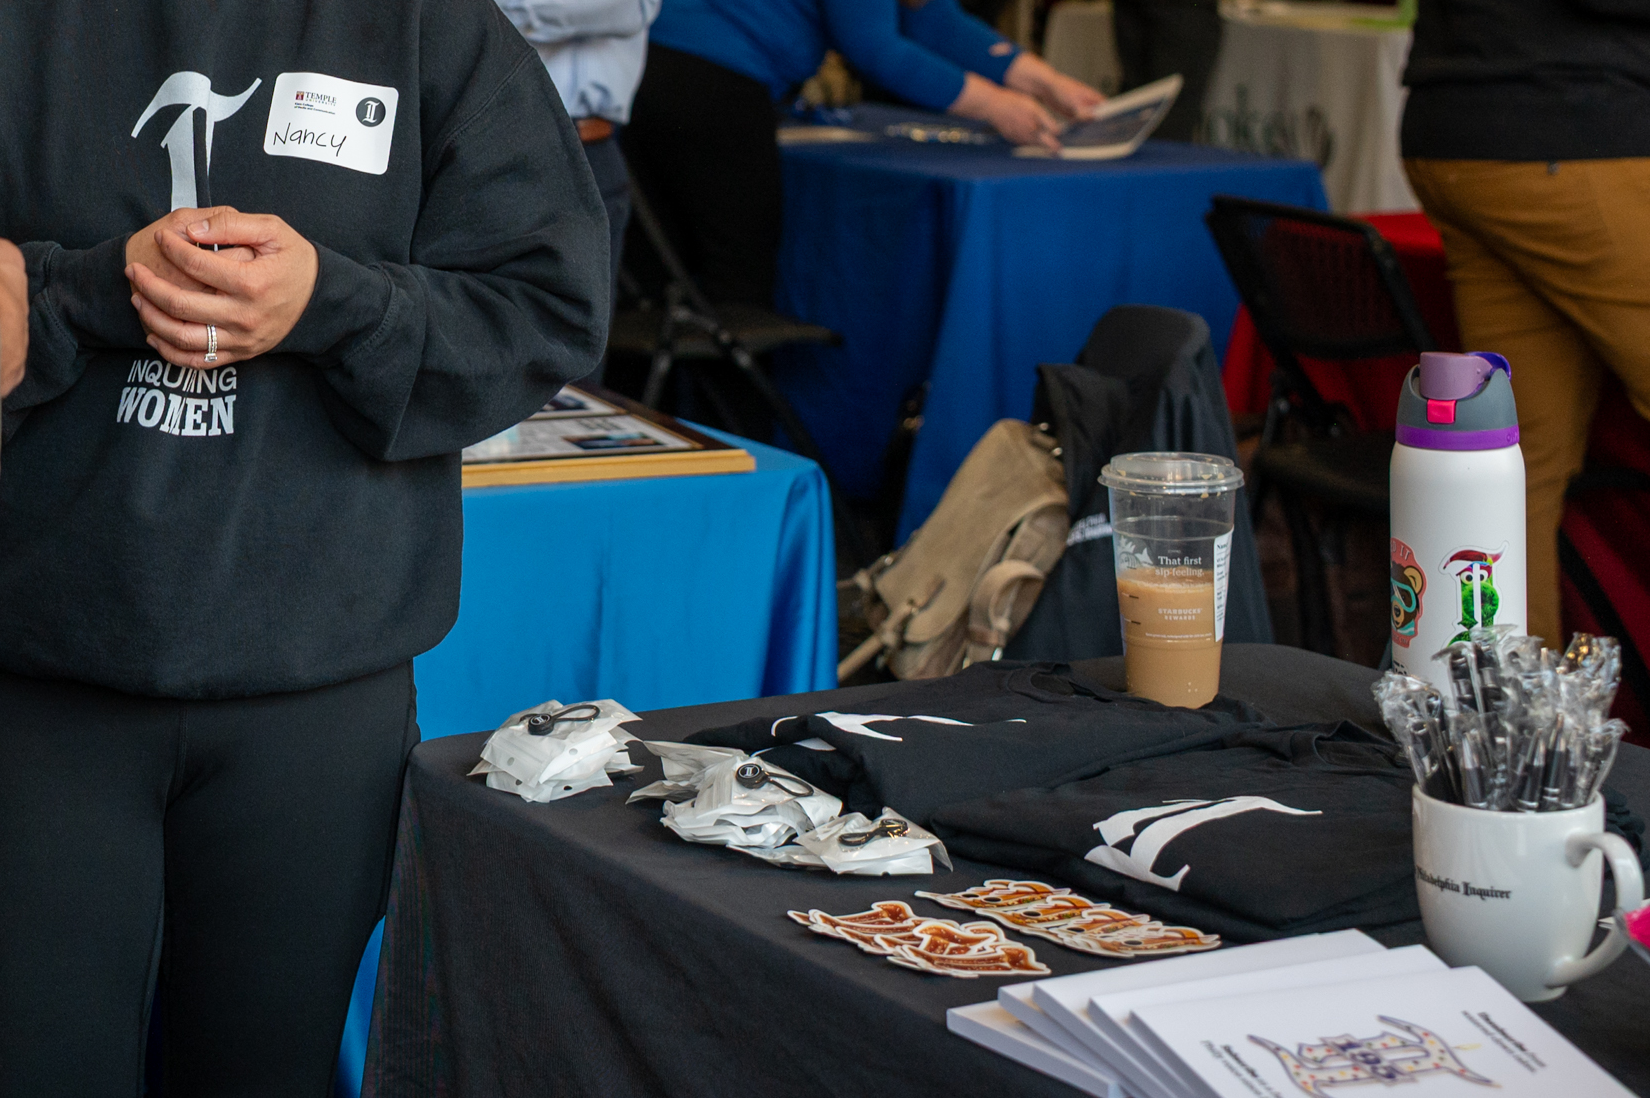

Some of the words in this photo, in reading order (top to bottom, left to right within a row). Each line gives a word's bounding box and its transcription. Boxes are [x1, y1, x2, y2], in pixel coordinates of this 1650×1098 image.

[305, 91, 337, 104] TEMPLE
[273, 122, 347, 157] Nancy
[116, 386, 237, 437] WOMEN
[1158, 555, 1181, 566] That
[1183, 555, 1202, 565] first
[1155, 567, 1170, 578] sip
[1172, 567, 1204, 578] feeling.
[1462, 881, 1512, 901] Inquirer
